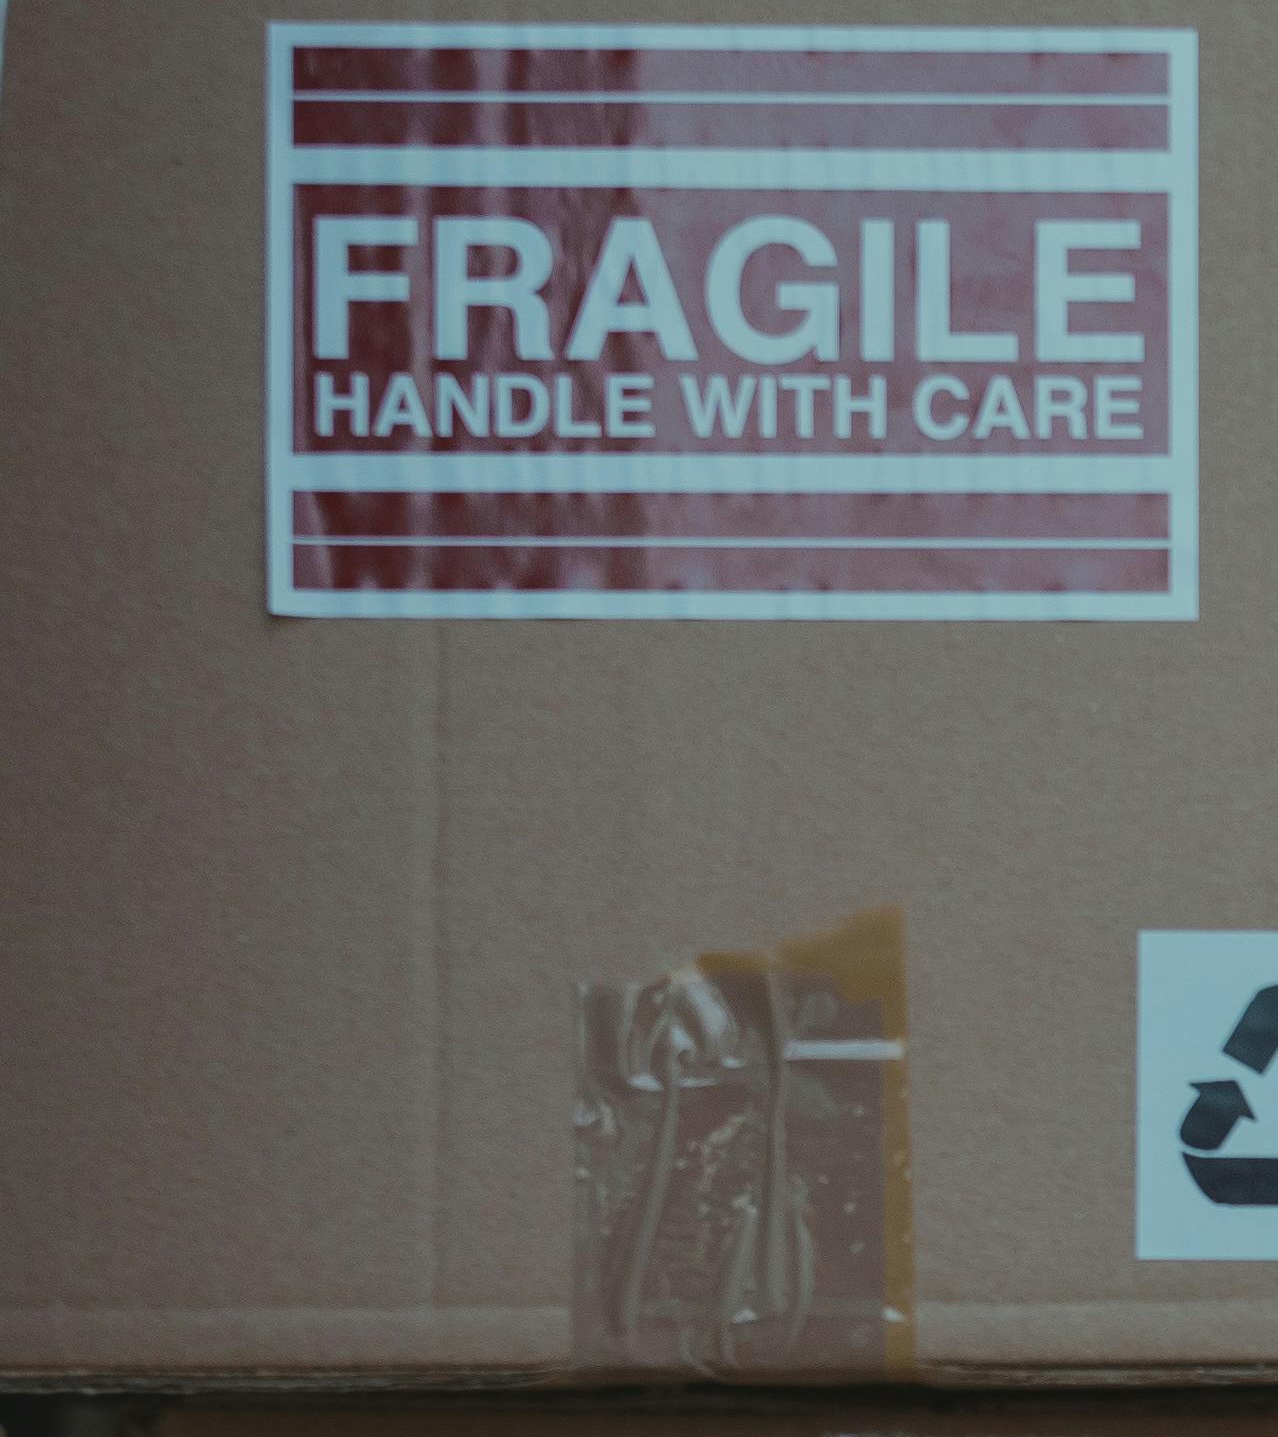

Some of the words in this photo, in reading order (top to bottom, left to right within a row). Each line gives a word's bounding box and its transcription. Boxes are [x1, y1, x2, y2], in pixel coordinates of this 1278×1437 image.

[312, 213, 1147, 365] FRAGILE
[313, 372, 657, 439] HANDLE
[678, 373, 888, 440] WITH
[911, 373, 1146, 441] CARE
